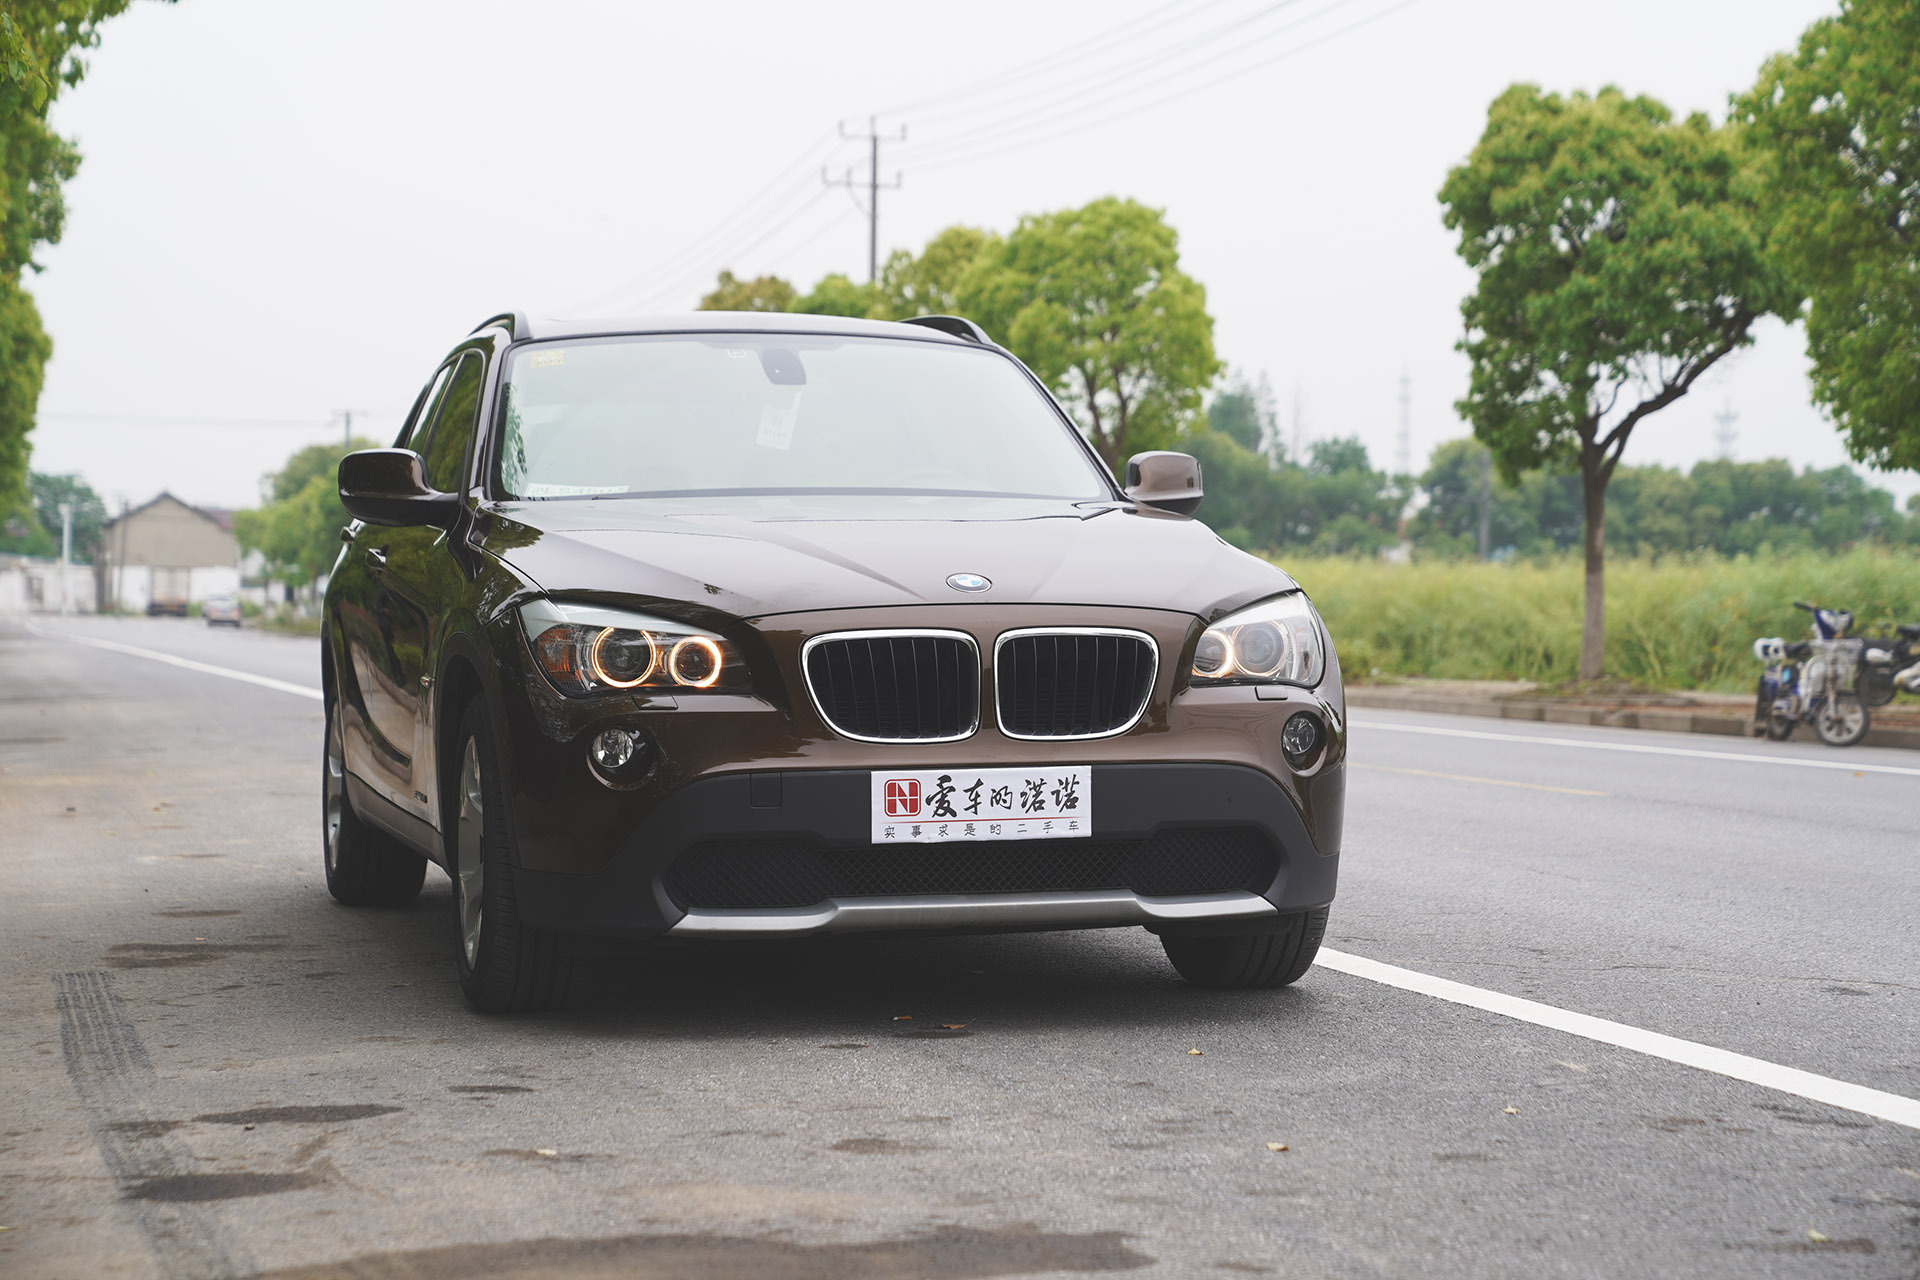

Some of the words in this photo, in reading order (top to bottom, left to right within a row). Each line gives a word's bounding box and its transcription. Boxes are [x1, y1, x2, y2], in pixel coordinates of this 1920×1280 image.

[925, 774, 1080, 818] 爱车的诺诺
[884, 820, 1079, 839] 实事求是的二手车
